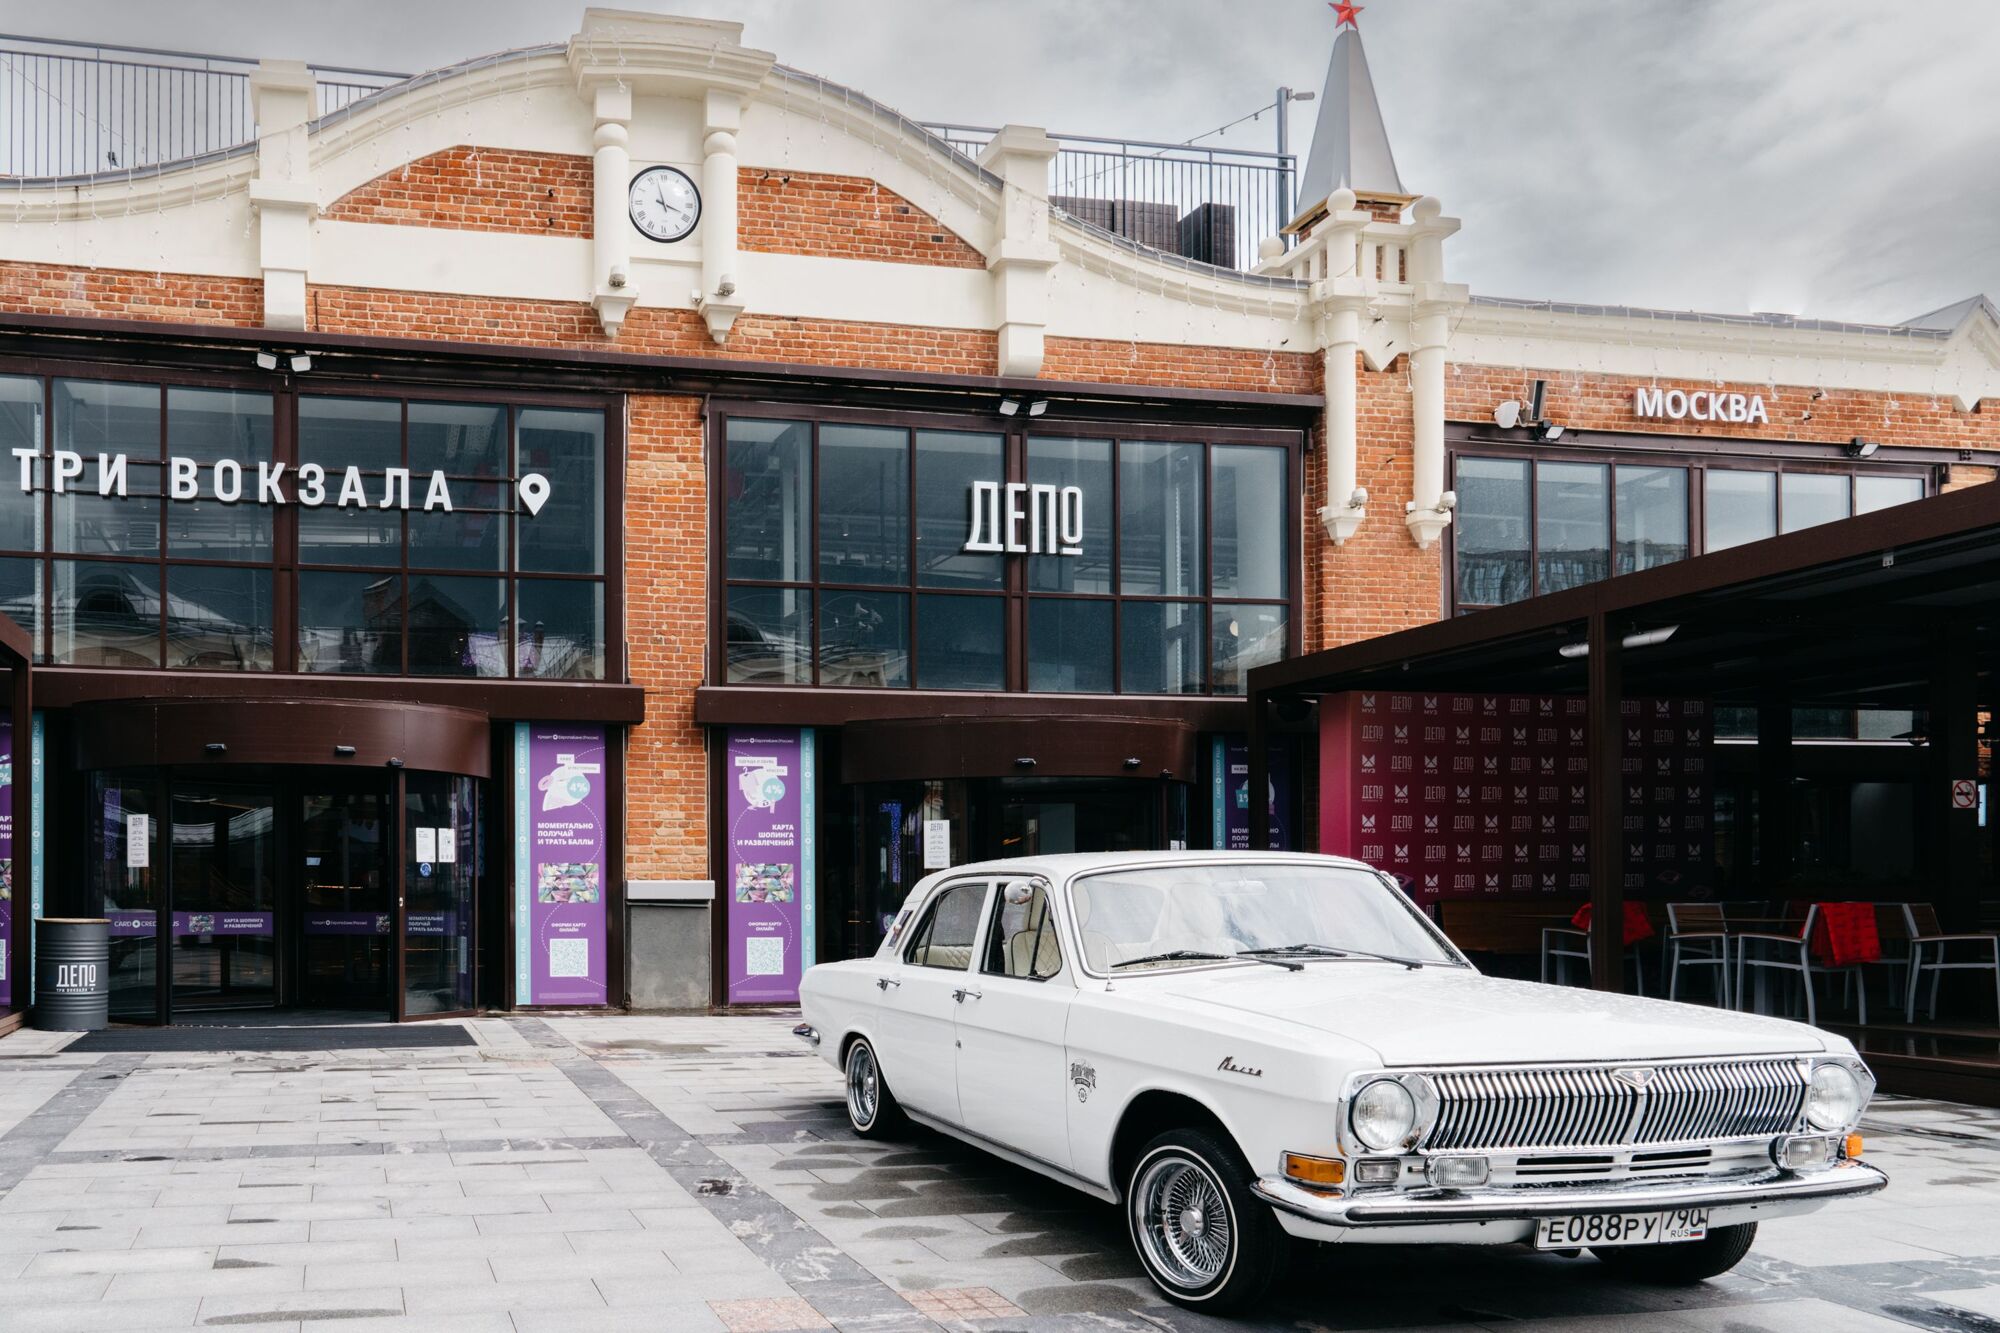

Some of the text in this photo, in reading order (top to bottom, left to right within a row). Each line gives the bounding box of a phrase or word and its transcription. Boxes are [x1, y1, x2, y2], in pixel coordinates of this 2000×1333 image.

[1636, 388, 1769, 424] МОСКВА
[12, 448, 453, 512] ТРИ ВОКЗАЛА
[964, 481, 1083, 555] ДЕПО
[1391, 696, 1412, 710] ДЕПО
[1452, 698, 1473, 711] ДЕПО
[1510, 699, 1530, 712] ДЕПО
[1566, 700, 1586, 713] ДЕПО
[1620, 700, 1640, 714] ДЕПО
[1362, 725, 1383, 739] ДЕПО
[1424, 726, 1445, 740] ДЕПО
[1481, 728, 1501, 741] ДЕПО
[1537, 728, 1557, 742] ДЕПО
[1654, 730, 1674, 743] ДЕПО
[1391, 756, 1412, 769] ДЕПО
[1453, 756, 1474, 770] ДЕПО
[1510, 757, 1531, 770] ДЕПО
[1568, 757, 1588, 771] ДЕПО
[1622, 758, 1642, 772] ДЕПО
[1362, 785, 1383, 799] ДЕПО
[1424, 786, 1446, 800] ДЕПО
[1481, 786, 1502, 800] ДЕПО
[1538, 786, 1559, 800] ДЕПО
[1655, 787, 1675, 800] ДЕПО
[1391, 815, 1412, 829] ДЕПО
[1453, 816, 1475, 829] ДЕПО
[1511, 816, 1532, 829] ДЕПО
[1569, 816, 1589, 829] ДЕПО
[1624, 816, 1644, 829] ДЕПО
[1362, 845, 1383, 859] ДЕПО
[1425, 845, 1446, 859] ДЕПО
[1481, 845, 1503, 859] ДЕПО
[1539, 845, 1560, 859] ДЕПО
[1656, 845, 1676, 858] ДЕПО
[1453, 874, 1475, 888] ДЕПО
[1512, 874, 1532, 888] ДЕПО
[1569, 874, 1590, 887] ДЕПО
[1624, 873, 1644, 887] ДЕПО
[56, 965, 96, 987] ДЕПО
[1665, 1209, 1702, 1230] 790
[1670, 1228, 1689, 1238] RUS
